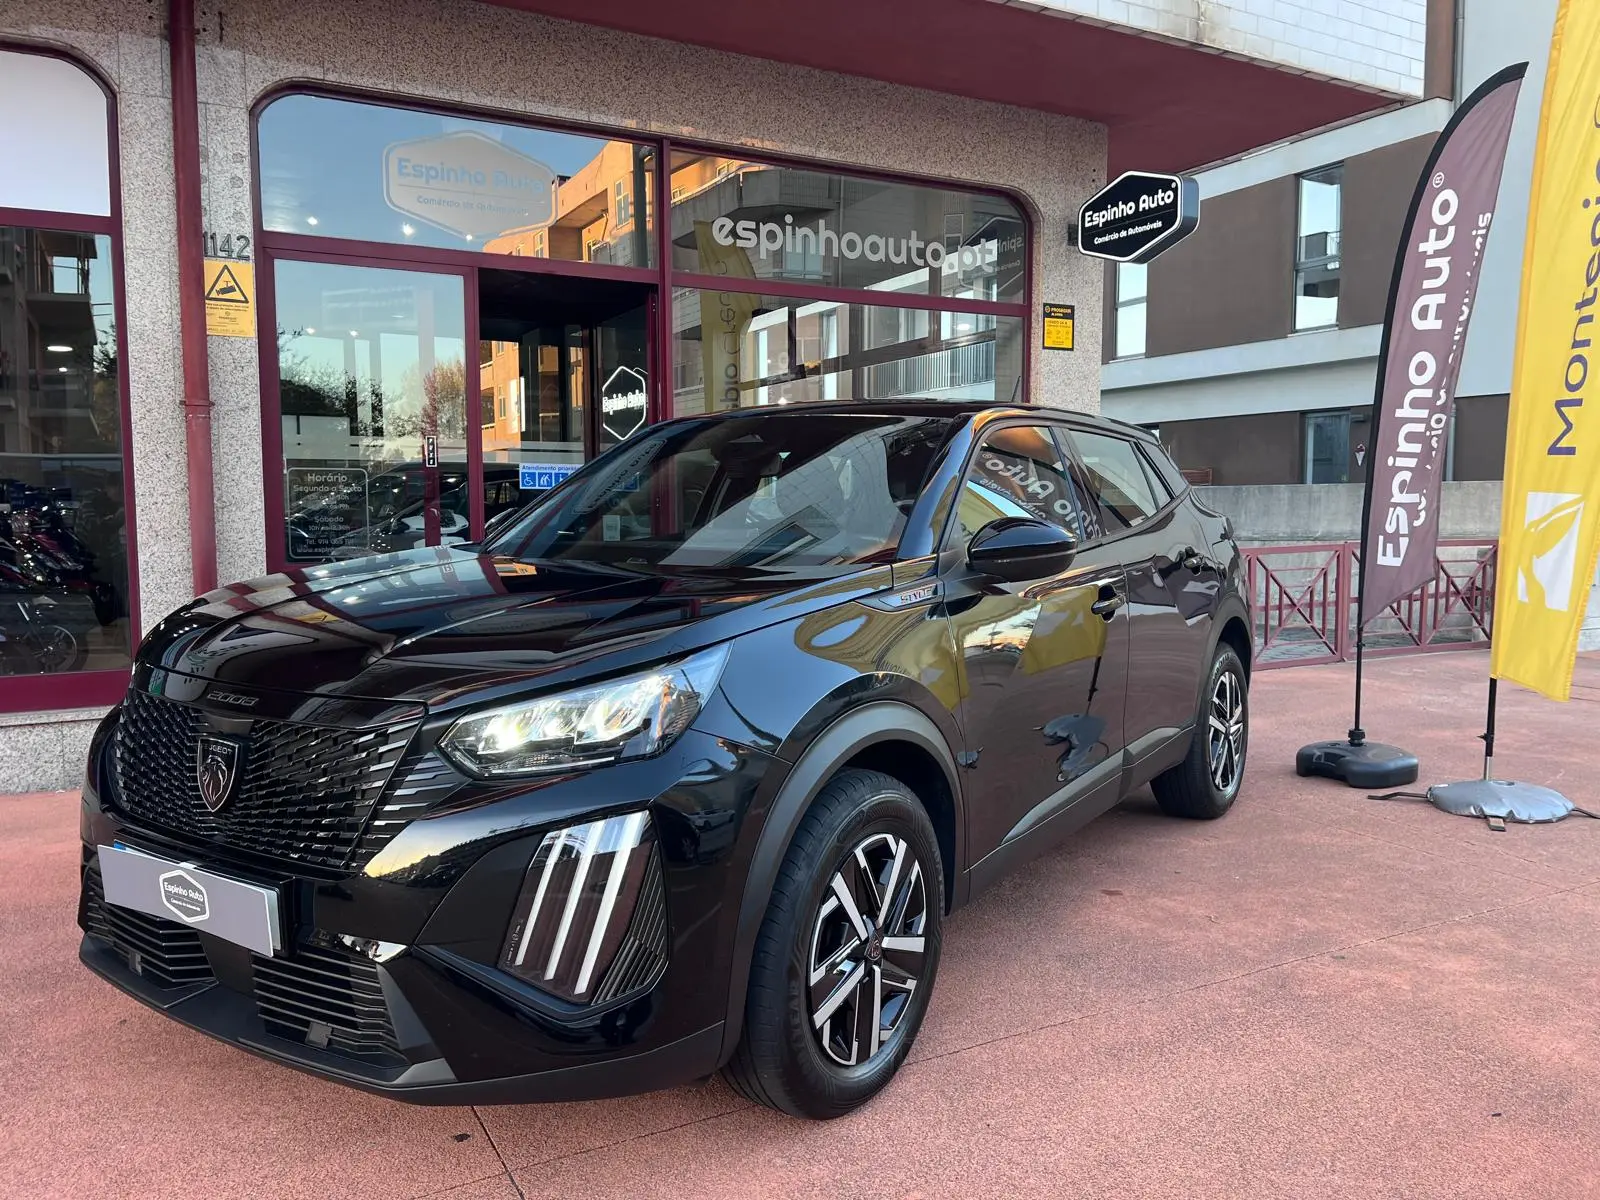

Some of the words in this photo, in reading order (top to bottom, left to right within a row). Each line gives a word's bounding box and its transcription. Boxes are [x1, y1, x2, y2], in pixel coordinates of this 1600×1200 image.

[396, 157, 486, 186] Espinho
[1084, 201, 1136, 228] Espinho
[1139, 189, 1174, 212] Auto
[1094, 233, 1119, 245] Comércio
[1119, 228, 1127, 237] de
[1128, 220, 1163, 236] Automóveis
[203, 231, 250, 260] 1142
[712, 214, 994, 279] espinhoauto.pt
[1376, 351, 1437, 567] Espinho
[1411, 188, 1459, 331] Auto
[293, 485, 329, 493] Segunda
[307, 473, 347, 482] Horário
[207, 690, 259, 706] 2008
[201, 742, 233, 755] EUGEOT
[164, 881, 188, 897] Espinho
